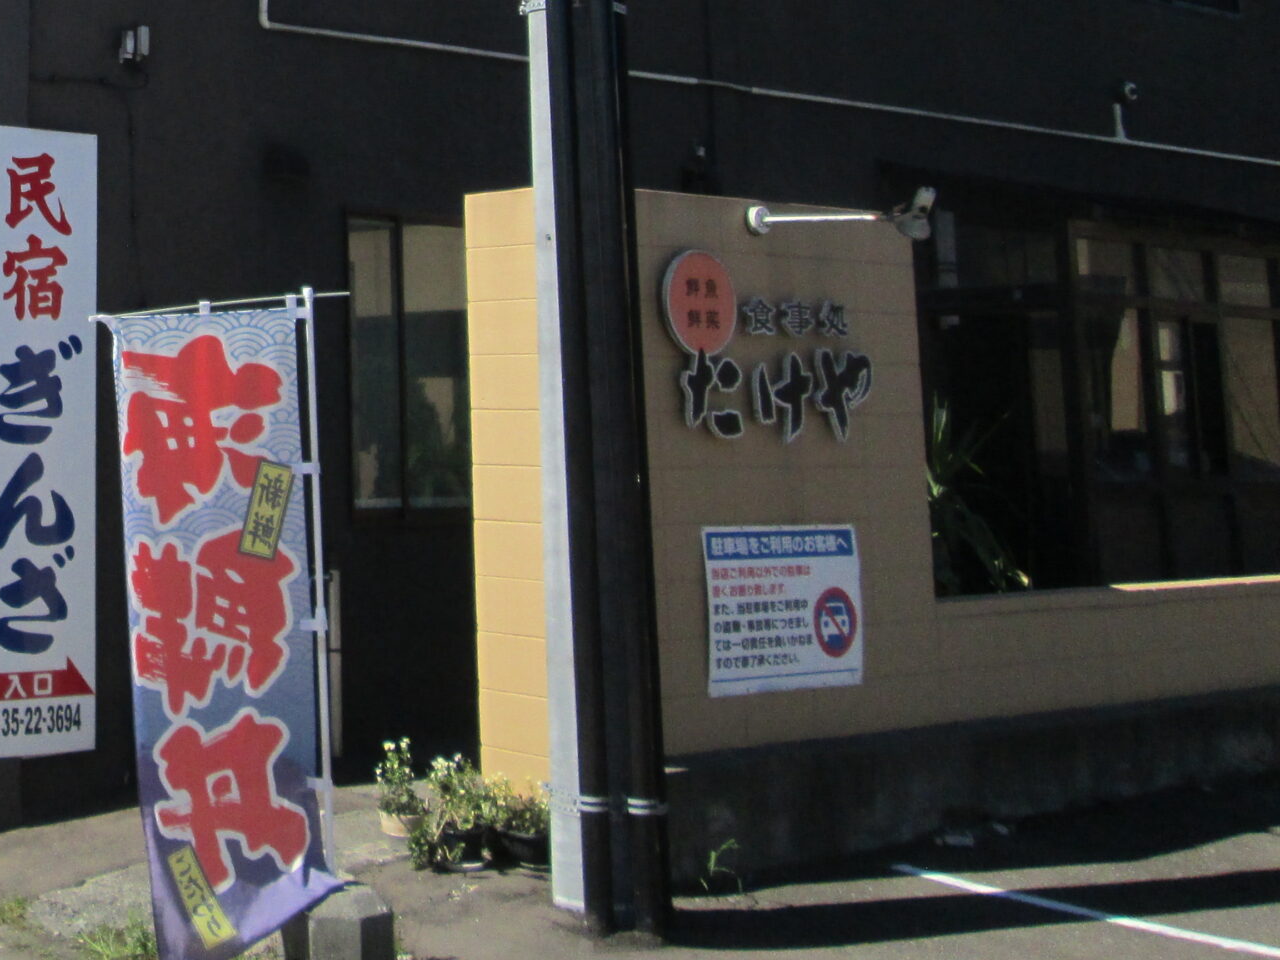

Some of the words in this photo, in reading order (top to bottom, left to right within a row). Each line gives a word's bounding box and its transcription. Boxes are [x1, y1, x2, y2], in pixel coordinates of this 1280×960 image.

[743, 298, 849, 337] 食事処
[4, 670, 53, 699] 入口
